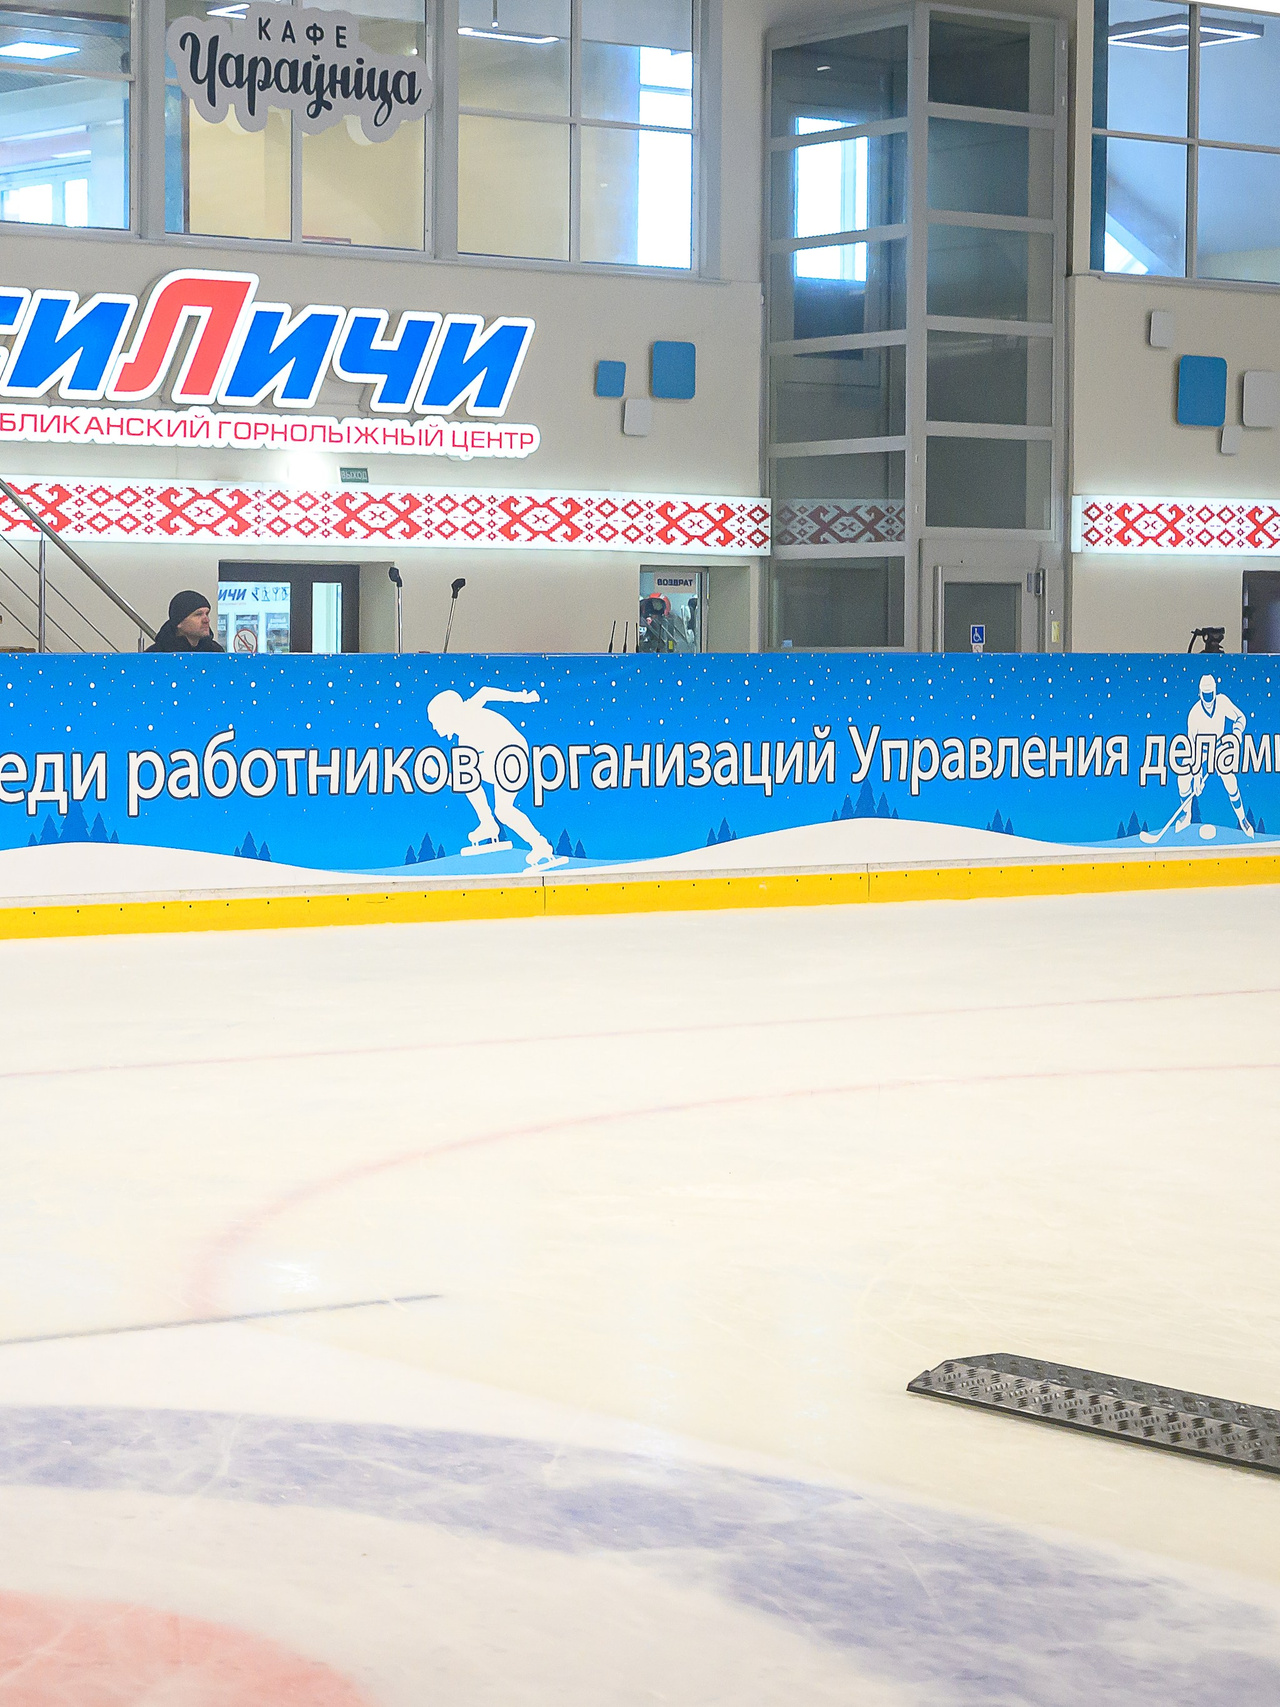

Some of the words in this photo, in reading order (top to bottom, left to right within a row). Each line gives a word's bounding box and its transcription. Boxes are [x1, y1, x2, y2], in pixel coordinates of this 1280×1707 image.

[257, 17, 348, 49] КАФЕ
[179, 31, 422, 127] Чараўніца
[218, 420, 444, 447] ГОРНОЛЫЖНЫЙ
[452, 430, 535, 452] ЦЕНТР
[218, 588, 248, 601] ИЧИ
[656, 578, 694, 587] ВОЗВРАТ
[127, 728, 483, 819] работников
[493, 725, 837, 809] организаций
[848, 723, 1130, 797] Управления
